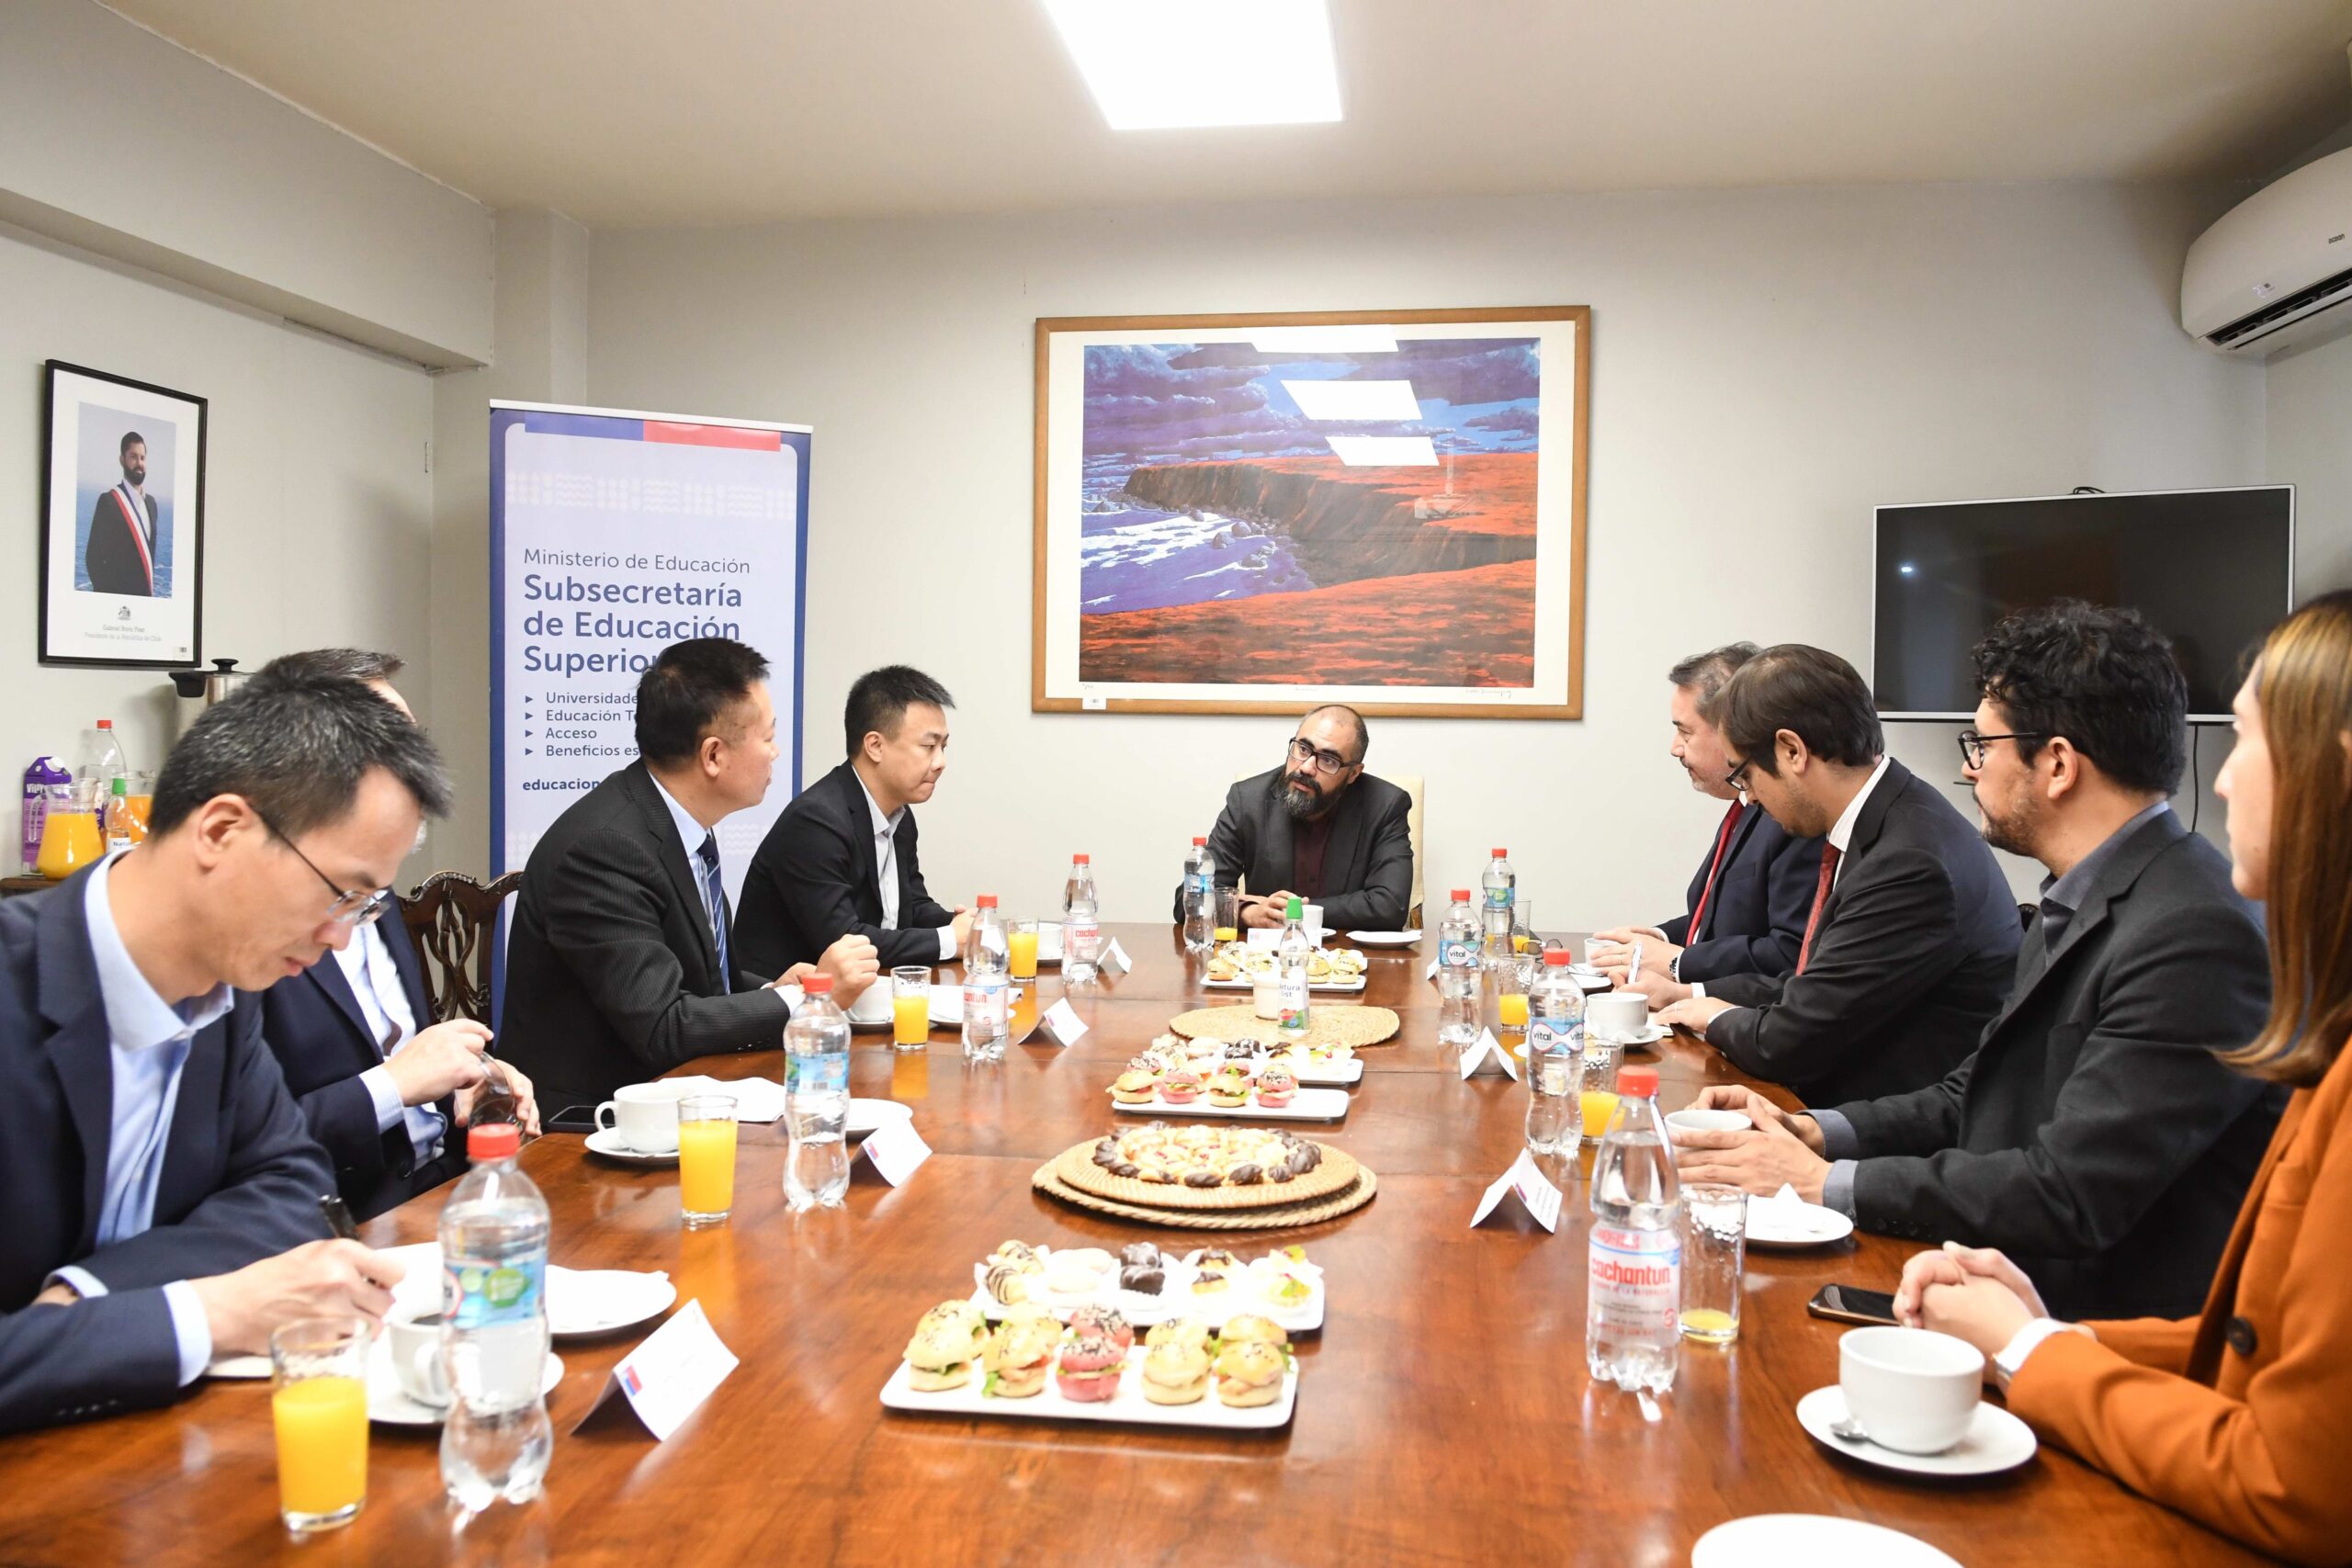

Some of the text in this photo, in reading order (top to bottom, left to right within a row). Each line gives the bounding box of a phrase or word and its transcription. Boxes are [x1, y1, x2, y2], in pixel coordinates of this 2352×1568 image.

[524, 548, 750, 573] Ministerio de Educación
[524, 574, 741, 607] Subsecretaría
[524, 611, 740, 640] de Educación
[546, 709, 621, 722] Educación
[545, 727, 597, 739] Acceso
[546, 745, 620, 757] Beneficios
[1449, 949, 1466, 958] vital
[1533, 1031, 1552, 1041] vital
